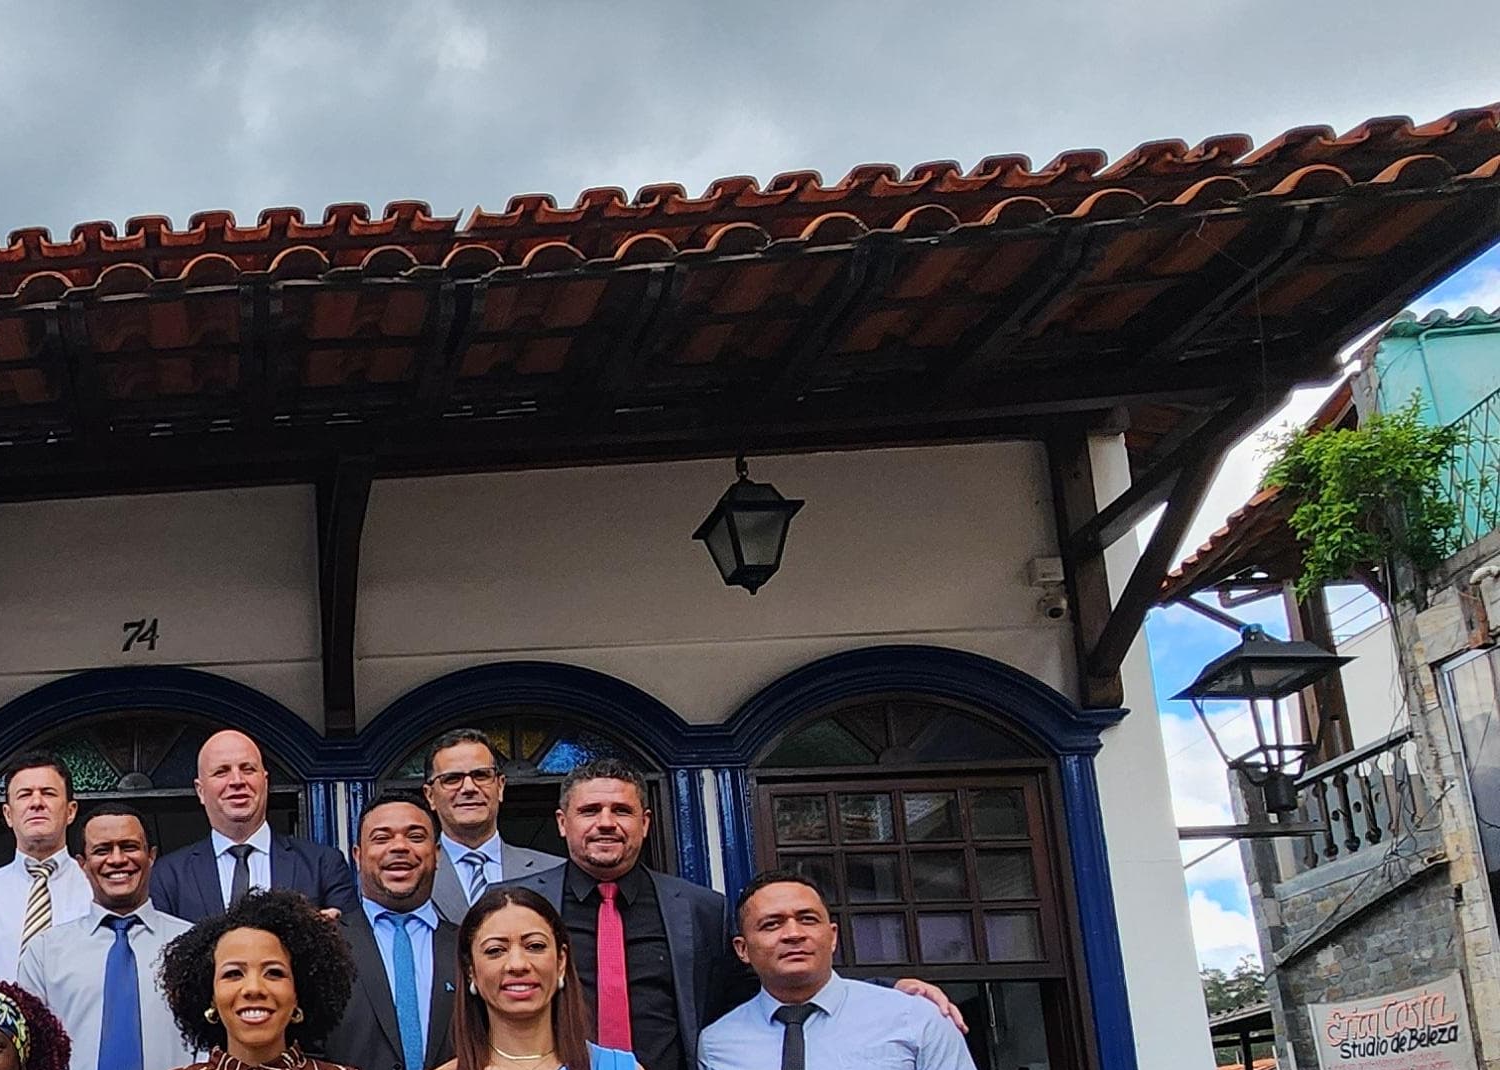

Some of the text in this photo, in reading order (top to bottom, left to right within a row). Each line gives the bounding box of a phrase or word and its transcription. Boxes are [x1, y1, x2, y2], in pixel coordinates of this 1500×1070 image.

[122, 618, 160, 652] 74
[1340, 1025, 1458, 1059] Studio de Beleza
